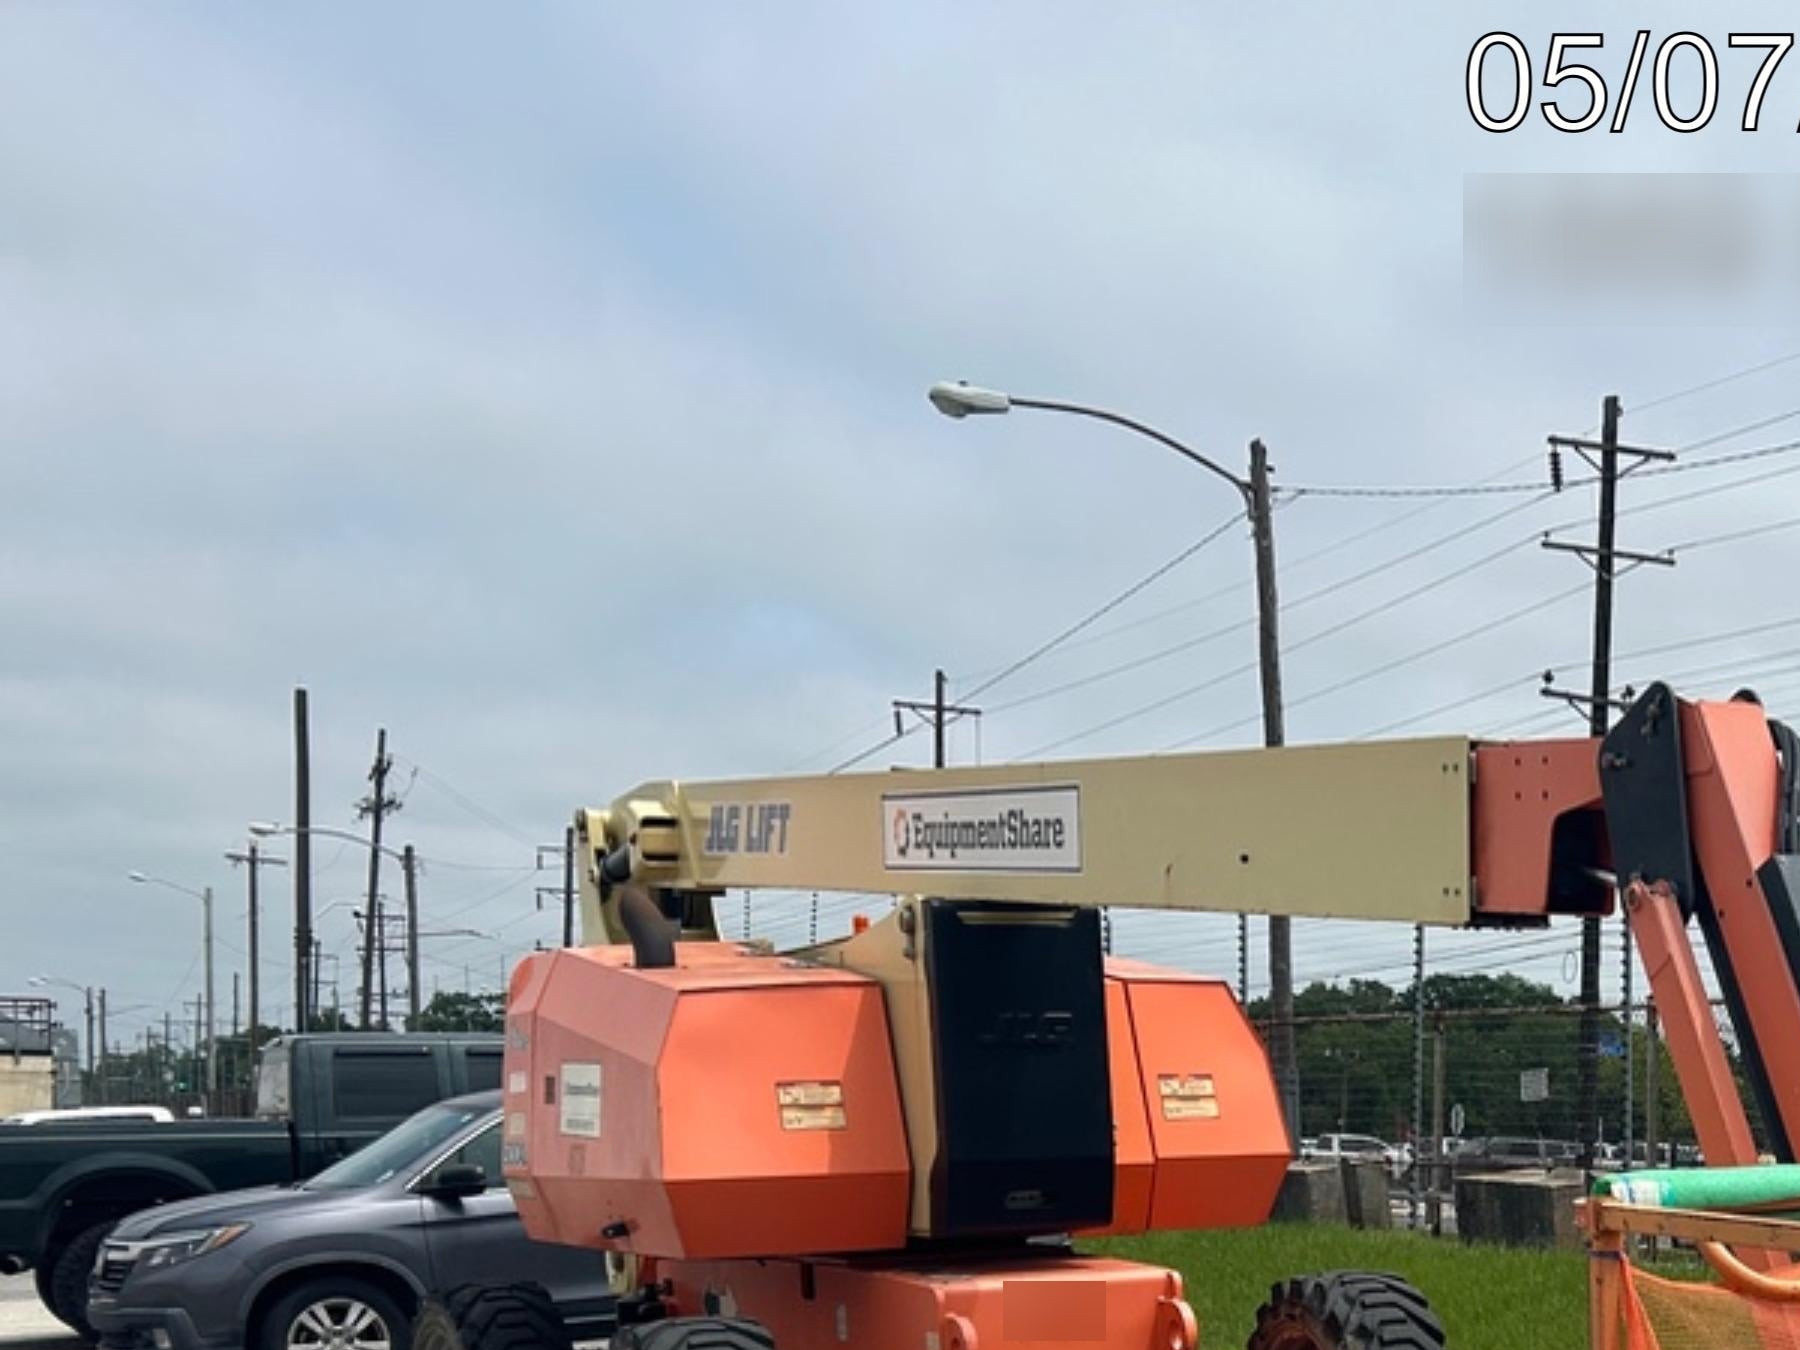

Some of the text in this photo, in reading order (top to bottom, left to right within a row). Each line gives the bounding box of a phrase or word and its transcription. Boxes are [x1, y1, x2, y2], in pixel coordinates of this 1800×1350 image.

[704, 802, 791, 854] JLG LIFT
[911, 809, 1065, 859] EquipmentShare
